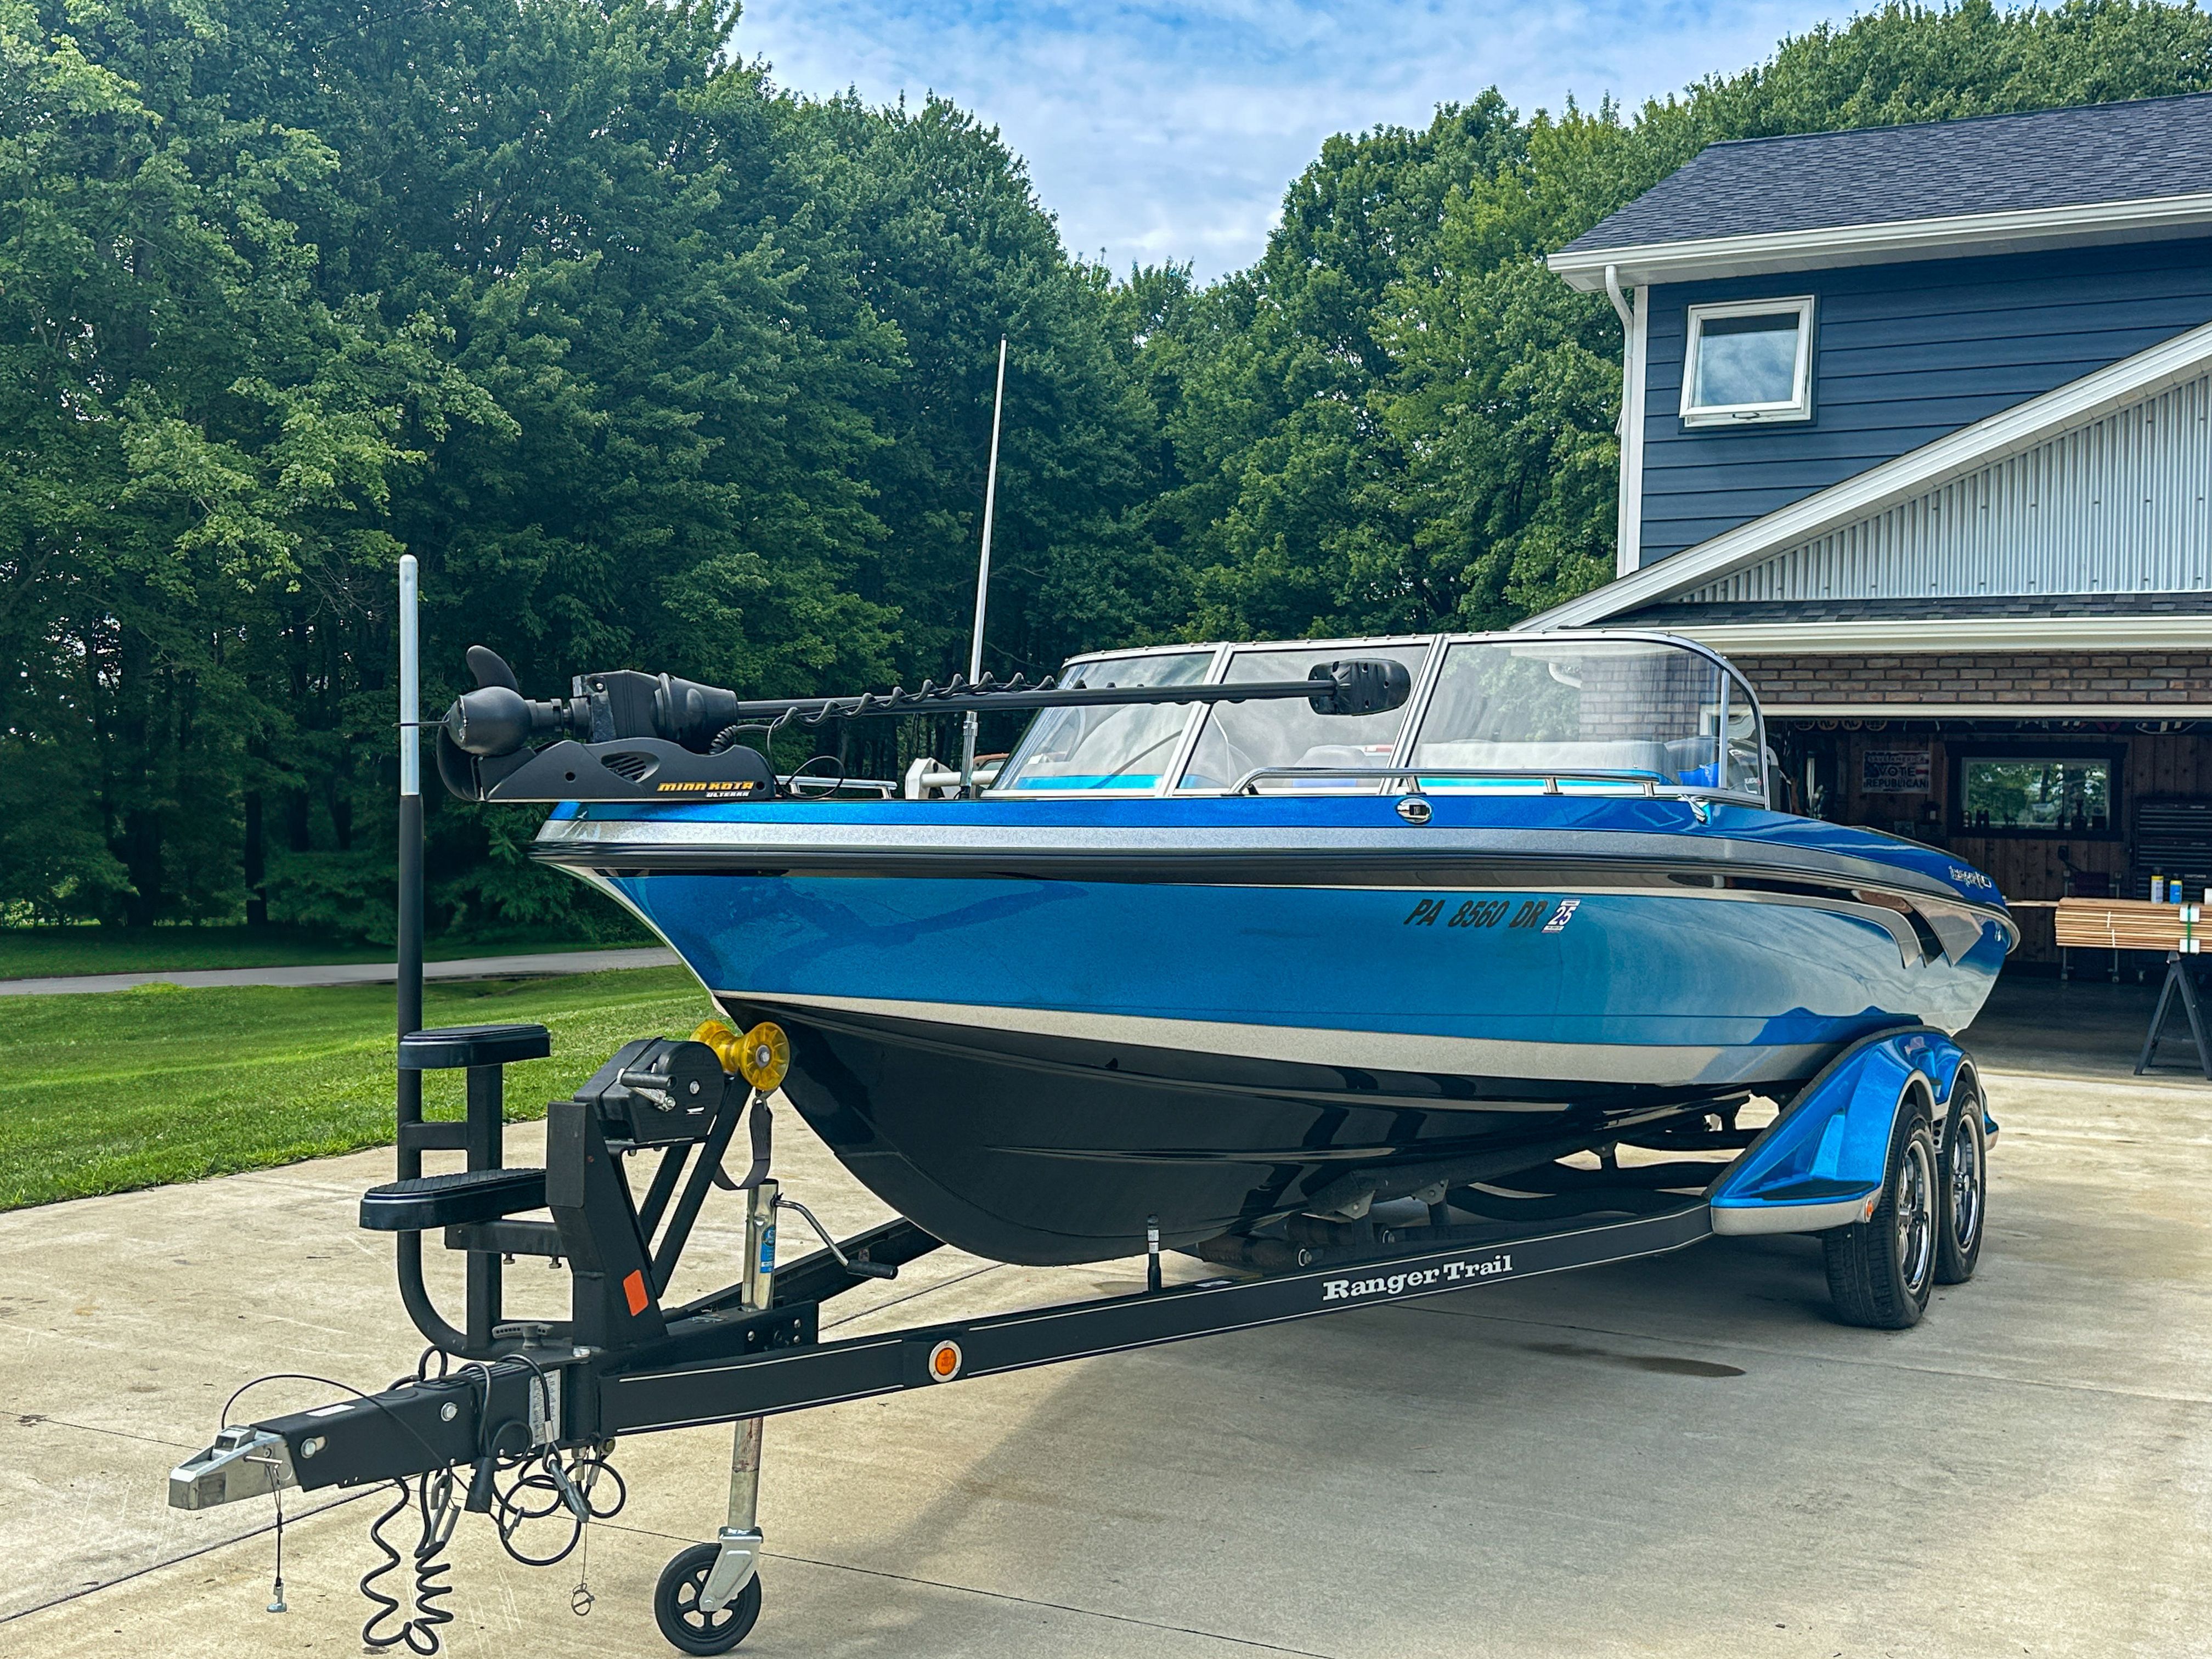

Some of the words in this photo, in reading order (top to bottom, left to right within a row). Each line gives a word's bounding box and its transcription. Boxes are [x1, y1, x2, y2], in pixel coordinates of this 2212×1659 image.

[1878, 766, 1915, 776] VOTE
[708, 781, 754, 791] KOTA
[1866, 778, 1926, 788] REPUBLICAN
[1403, 899, 1446, 926] PA
[1448, 900, 1510, 928] 8560
[1508, 900, 1549, 928] DR
[1547, 906, 1577, 926] 25
[1322, 1268, 1441, 1301] Ranger
[1443, 1254, 1513, 1282] Trail
